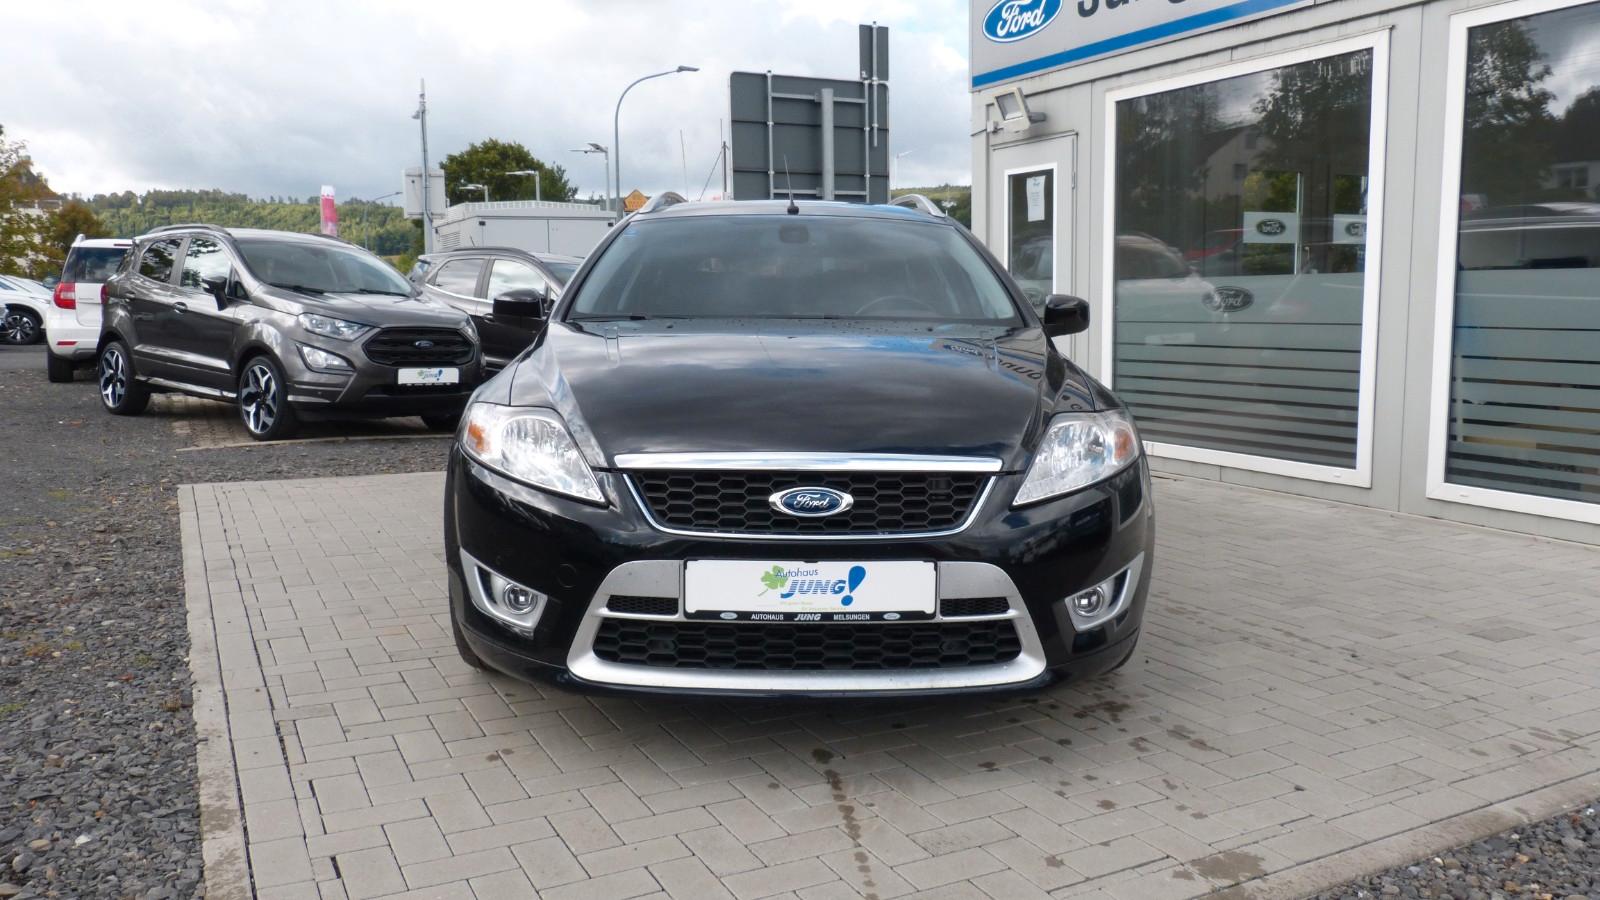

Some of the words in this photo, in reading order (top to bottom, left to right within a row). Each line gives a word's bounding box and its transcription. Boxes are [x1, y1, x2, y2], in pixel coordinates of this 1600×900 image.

[997, 0, 1046, 37] Ford
[794, 494, 830, 508] Ford
[775, 568, 819, 578] Autohaus
